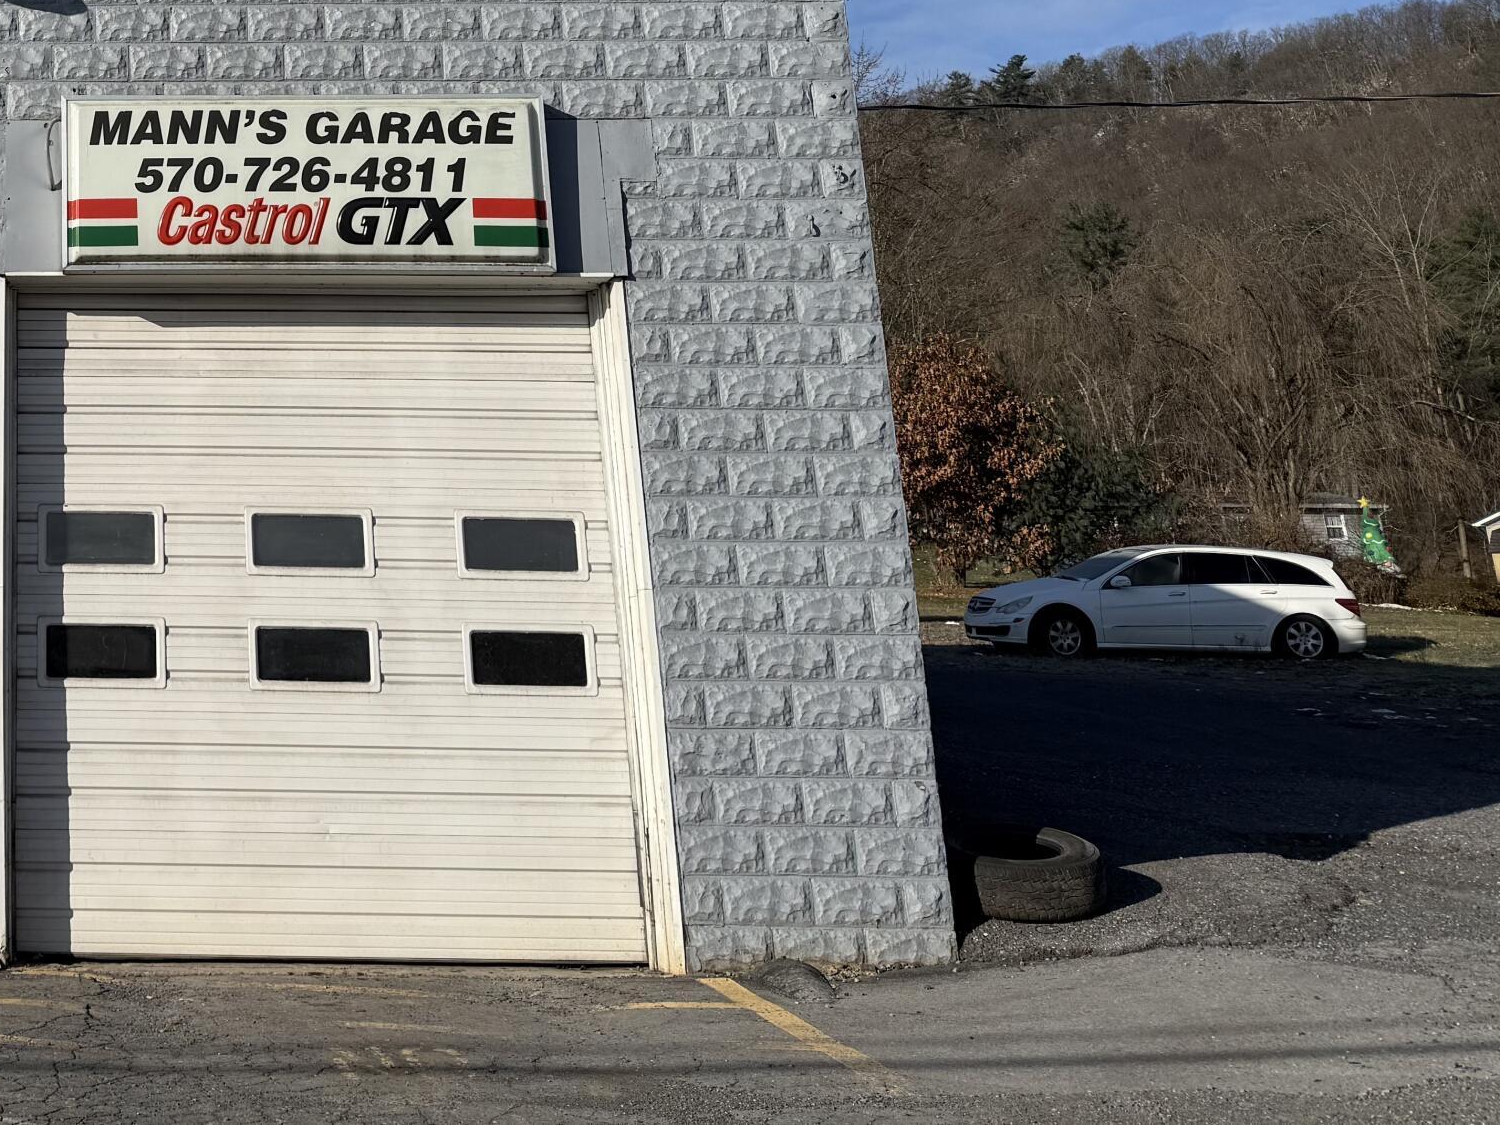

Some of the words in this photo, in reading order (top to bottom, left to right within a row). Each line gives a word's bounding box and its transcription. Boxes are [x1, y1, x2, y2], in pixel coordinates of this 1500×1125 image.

[90, 109, 288, 145] MANN'S
[305, 109, 516, 145] GARAGE
[134, 156, 467, 193] 570-726-4811
[157, 195, 331, 246] Castrol
[336, 197, 468, 246] GTX
